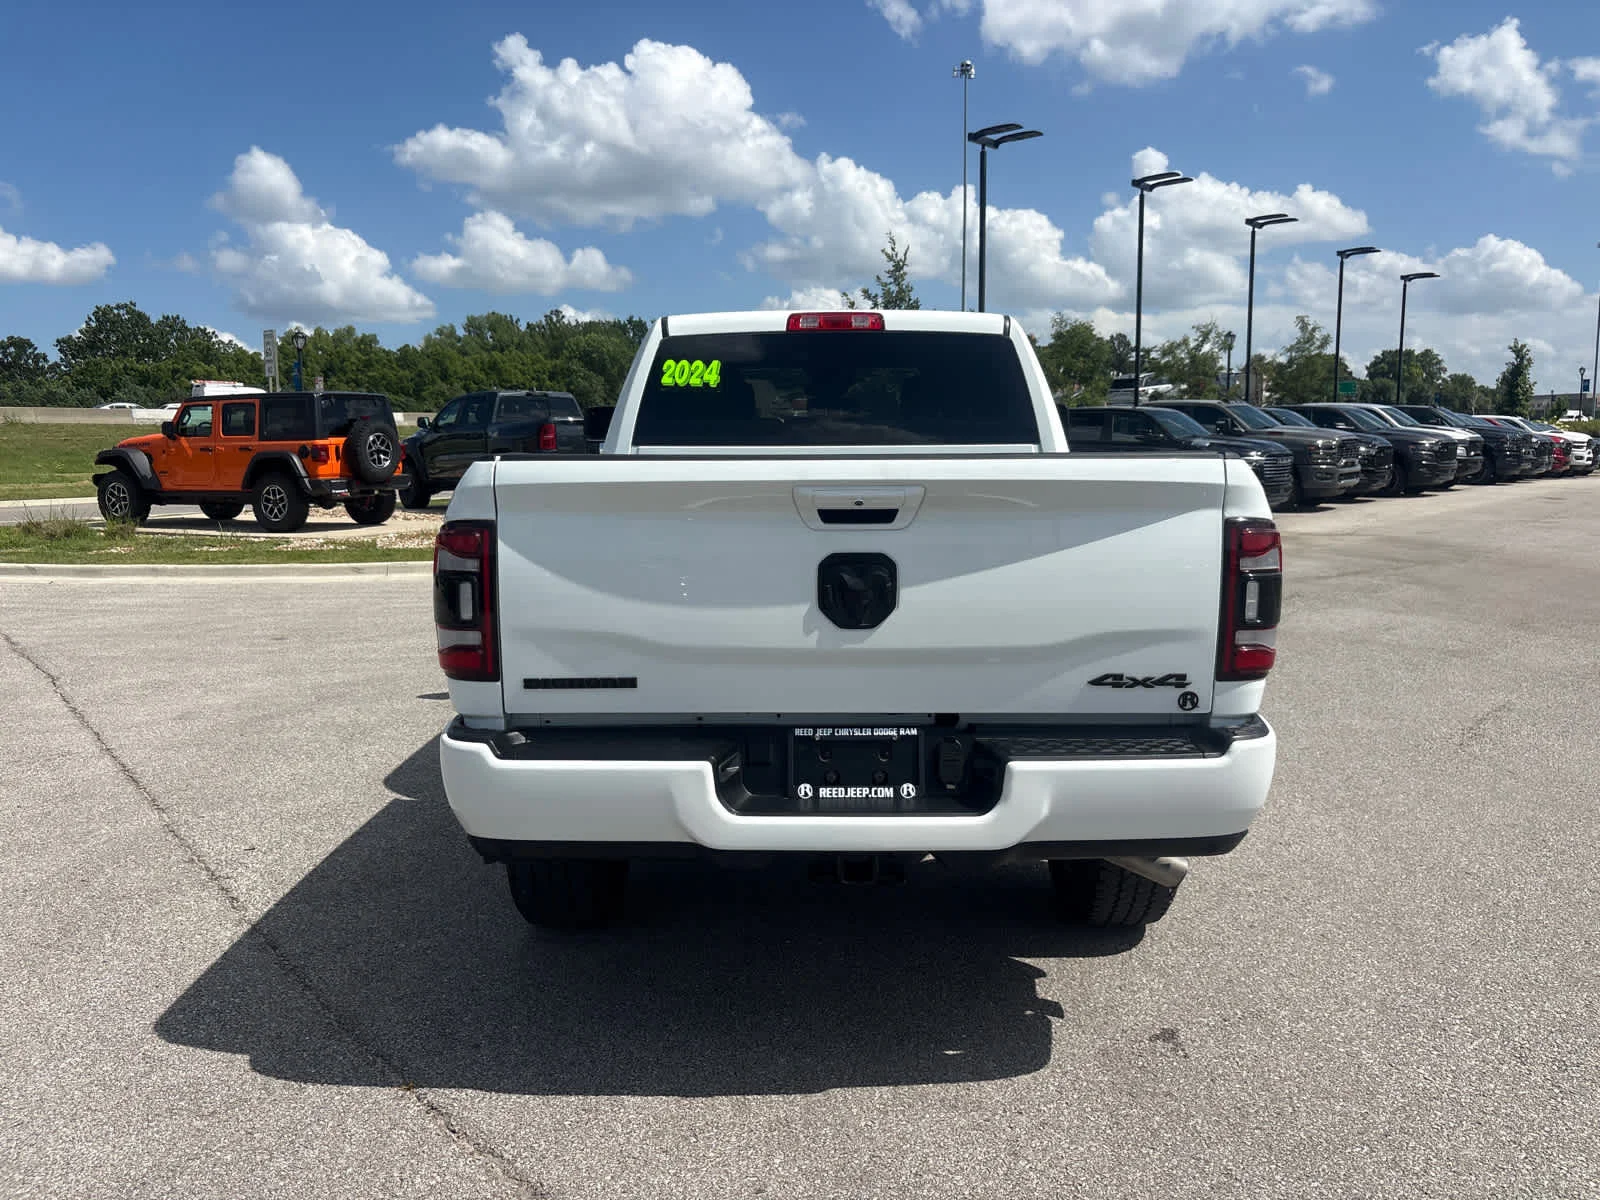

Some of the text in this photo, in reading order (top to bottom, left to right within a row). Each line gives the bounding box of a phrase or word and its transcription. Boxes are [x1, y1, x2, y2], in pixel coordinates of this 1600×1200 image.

[660, 359, 722, 388] 2024
[1087, 673, 1192, 688] 4x4
[795, 728, 918, 736] REED JEEP CHRYSLER DODGE RAM
[819, 787, 894, 798] REEDJEEP.COM
